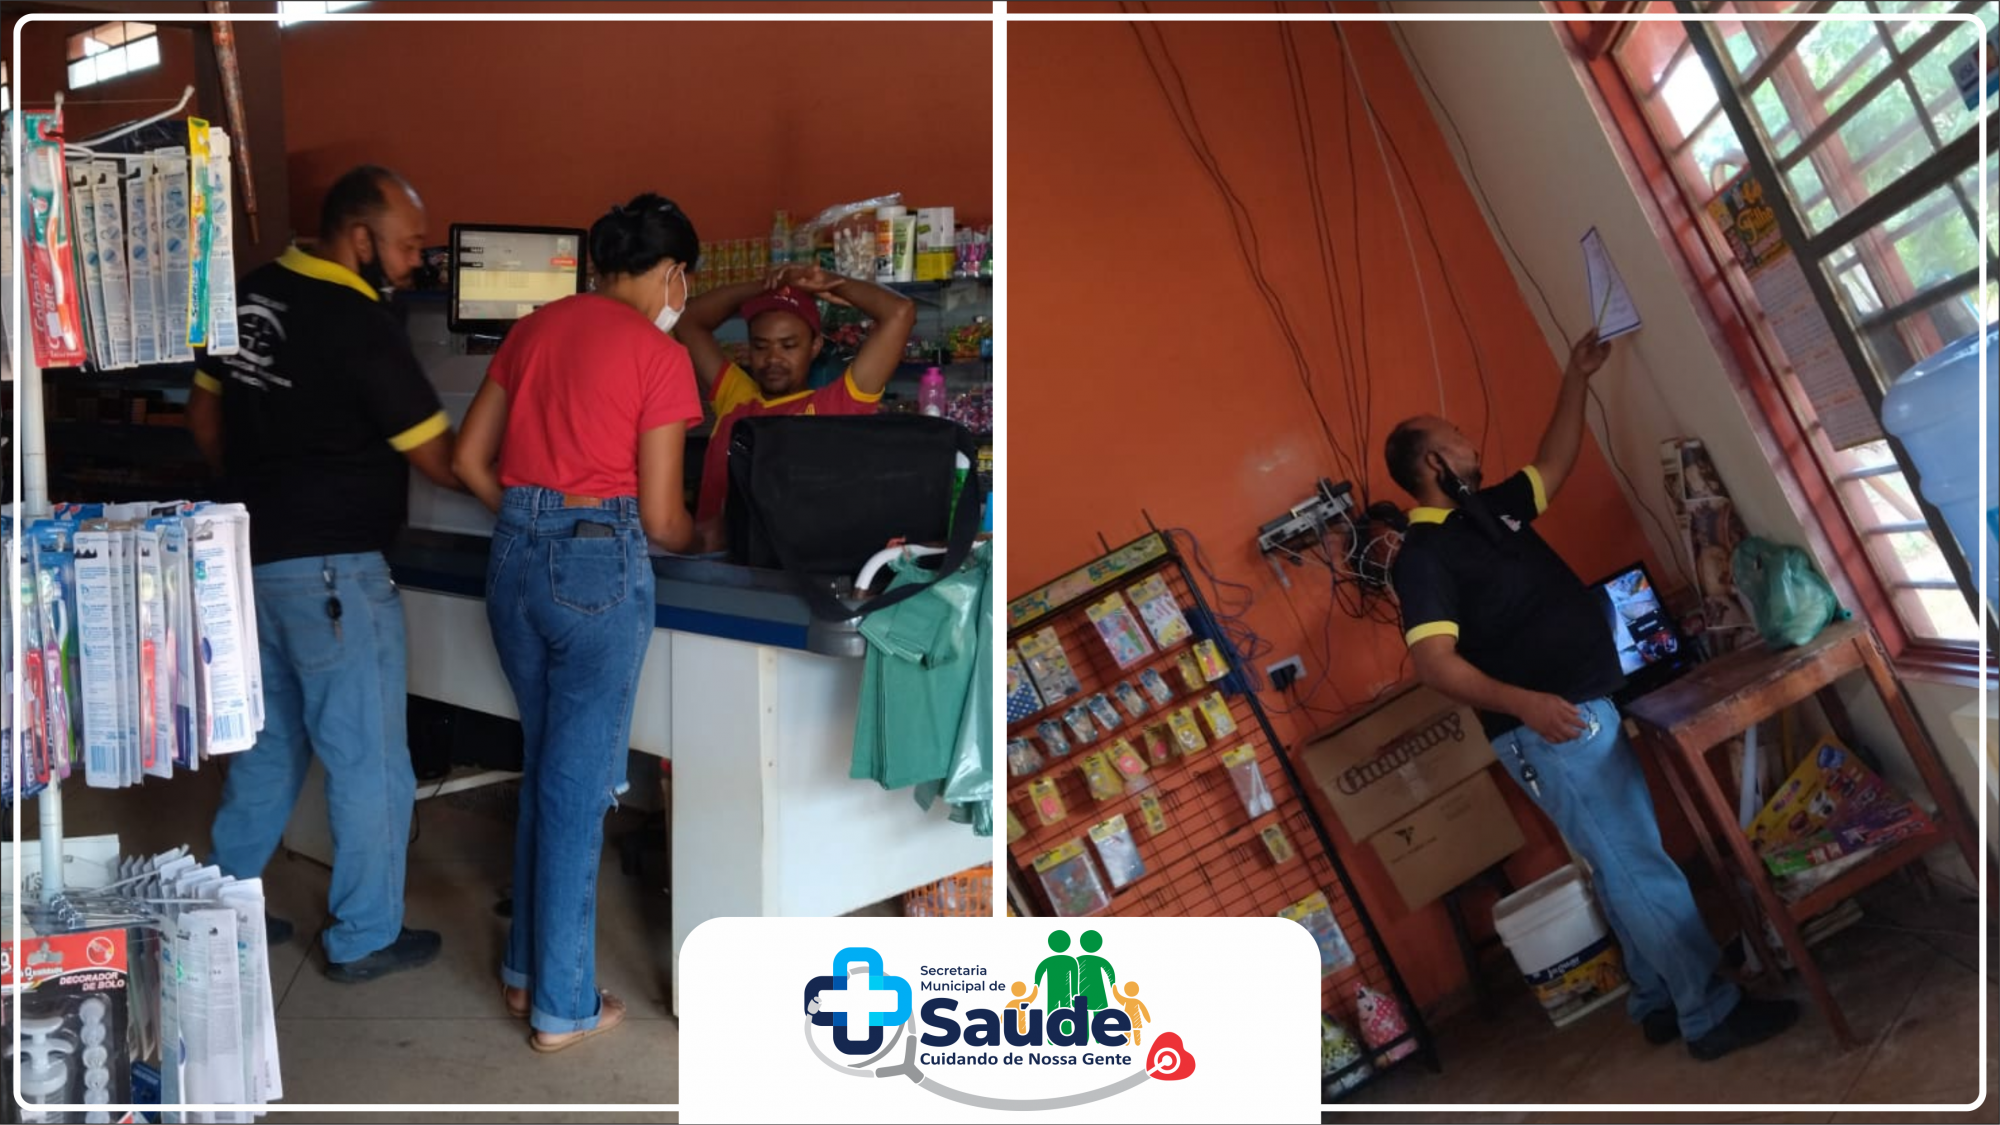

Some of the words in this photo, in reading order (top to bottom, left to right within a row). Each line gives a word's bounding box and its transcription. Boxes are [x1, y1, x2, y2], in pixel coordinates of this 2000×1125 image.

[60, 972, 119, 985] DECORADOR
[82, 983, 97, 992] DE
[97, 979, 125, 990] BOLO
